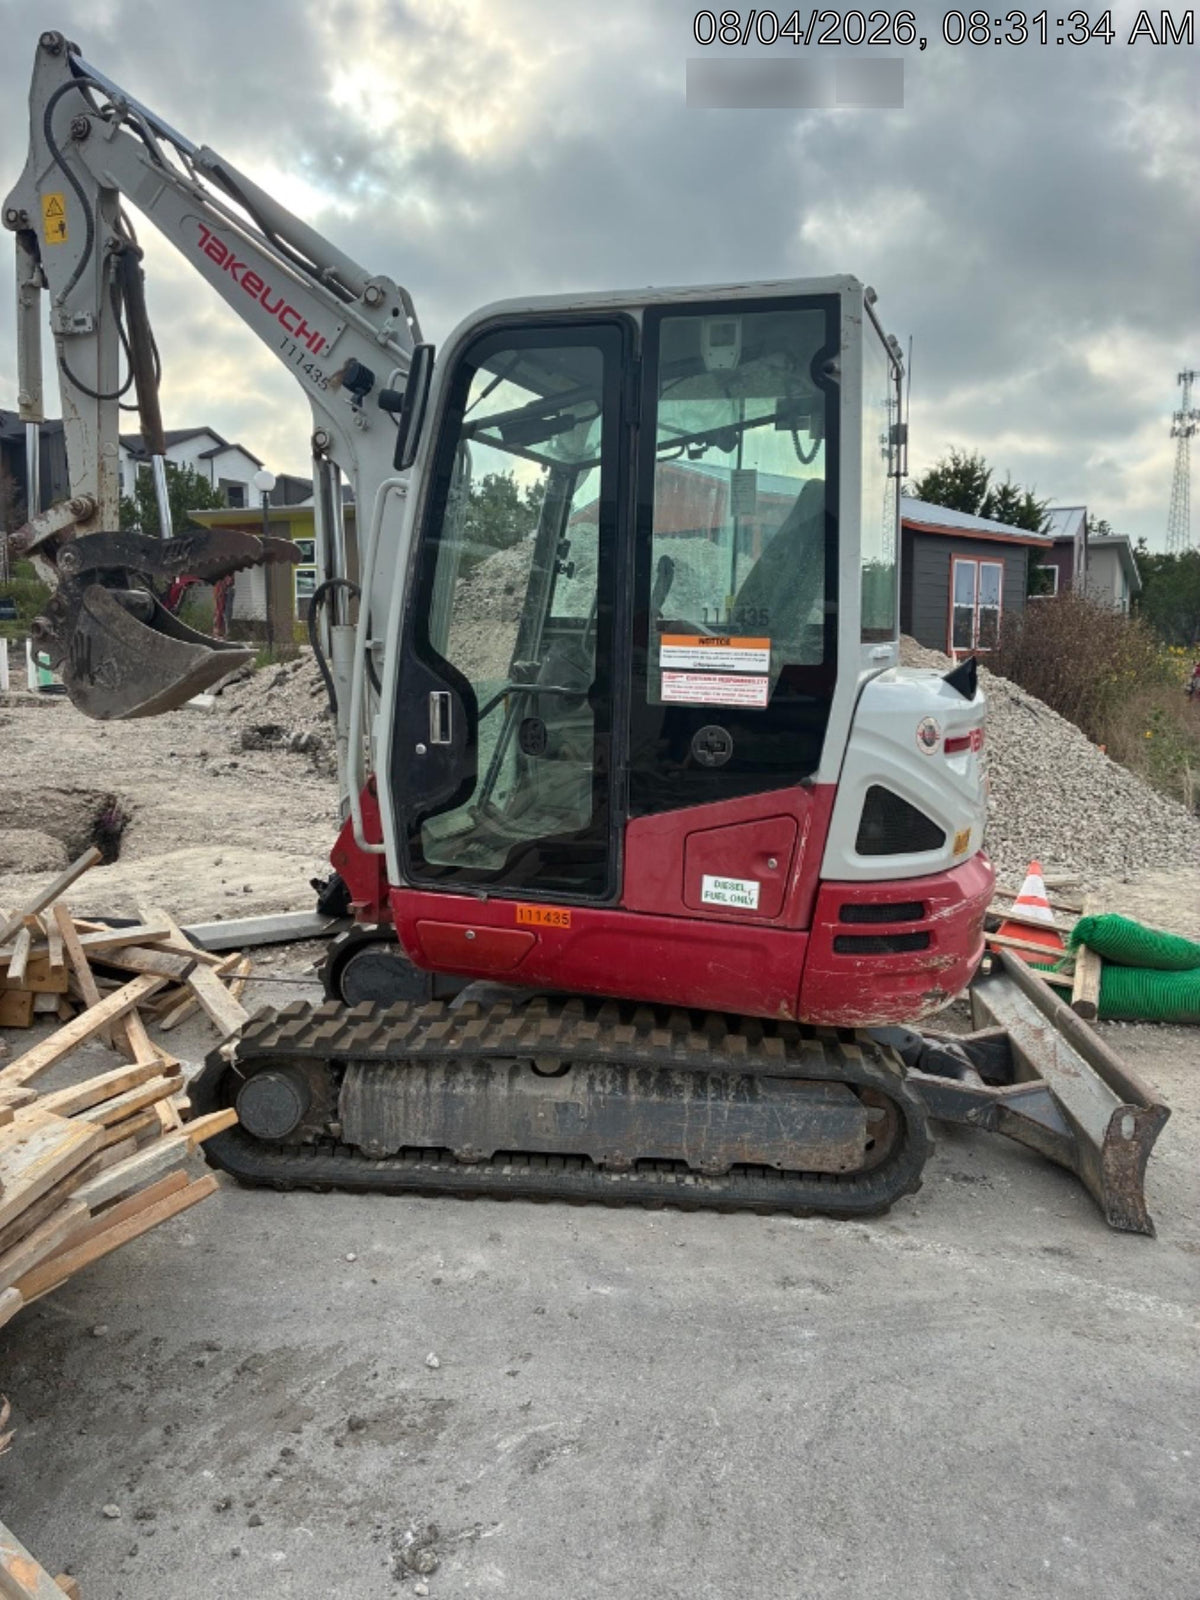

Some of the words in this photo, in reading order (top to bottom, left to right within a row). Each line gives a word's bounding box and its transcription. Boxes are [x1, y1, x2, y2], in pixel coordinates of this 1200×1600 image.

[279, 337, 330, 391] 111435
[702, 607, 769, 626] 111435
[714, 880, 744, 891] DIESEL
[704, 890, 728, 902] FUEL
[730, 894, 755, 906] ONLY
[519, 908, 570, 925] 111435
